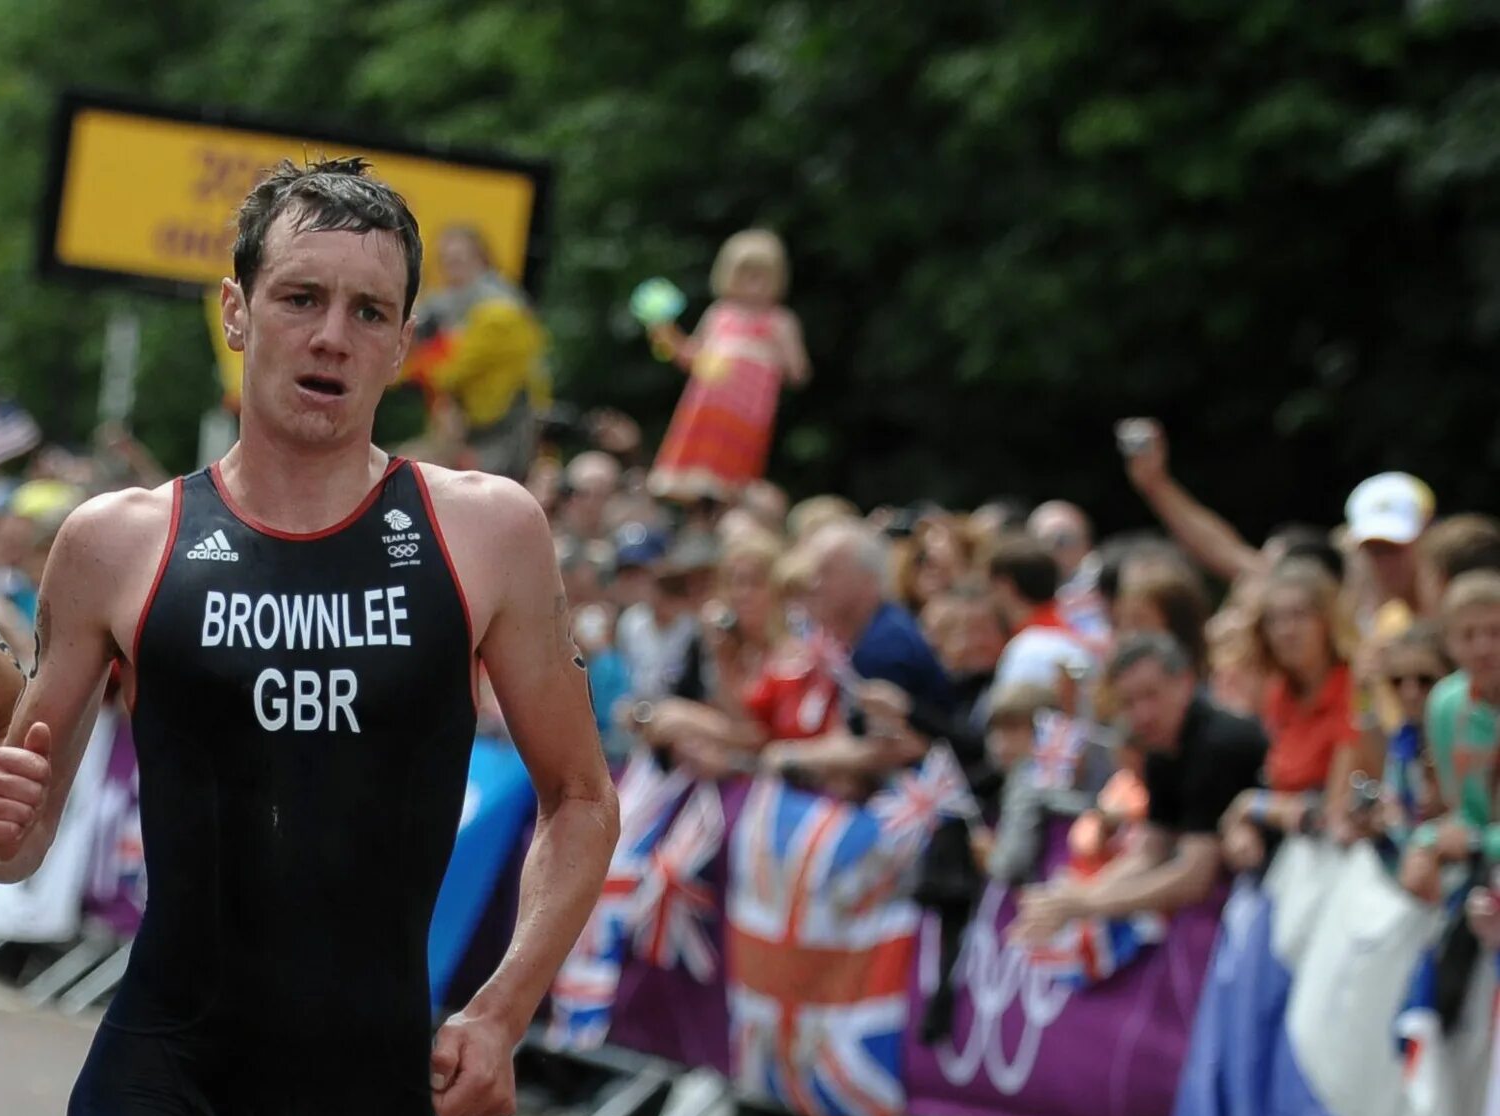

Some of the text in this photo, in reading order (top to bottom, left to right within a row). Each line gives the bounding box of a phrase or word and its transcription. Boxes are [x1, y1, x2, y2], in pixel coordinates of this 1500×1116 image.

[186, 549, 239, 562] adidas
[382, 532, 421, 544] TEAM GB
[201, 585, 412, 650] BROWNLEE
[253, 667, 361, 733] GBR
